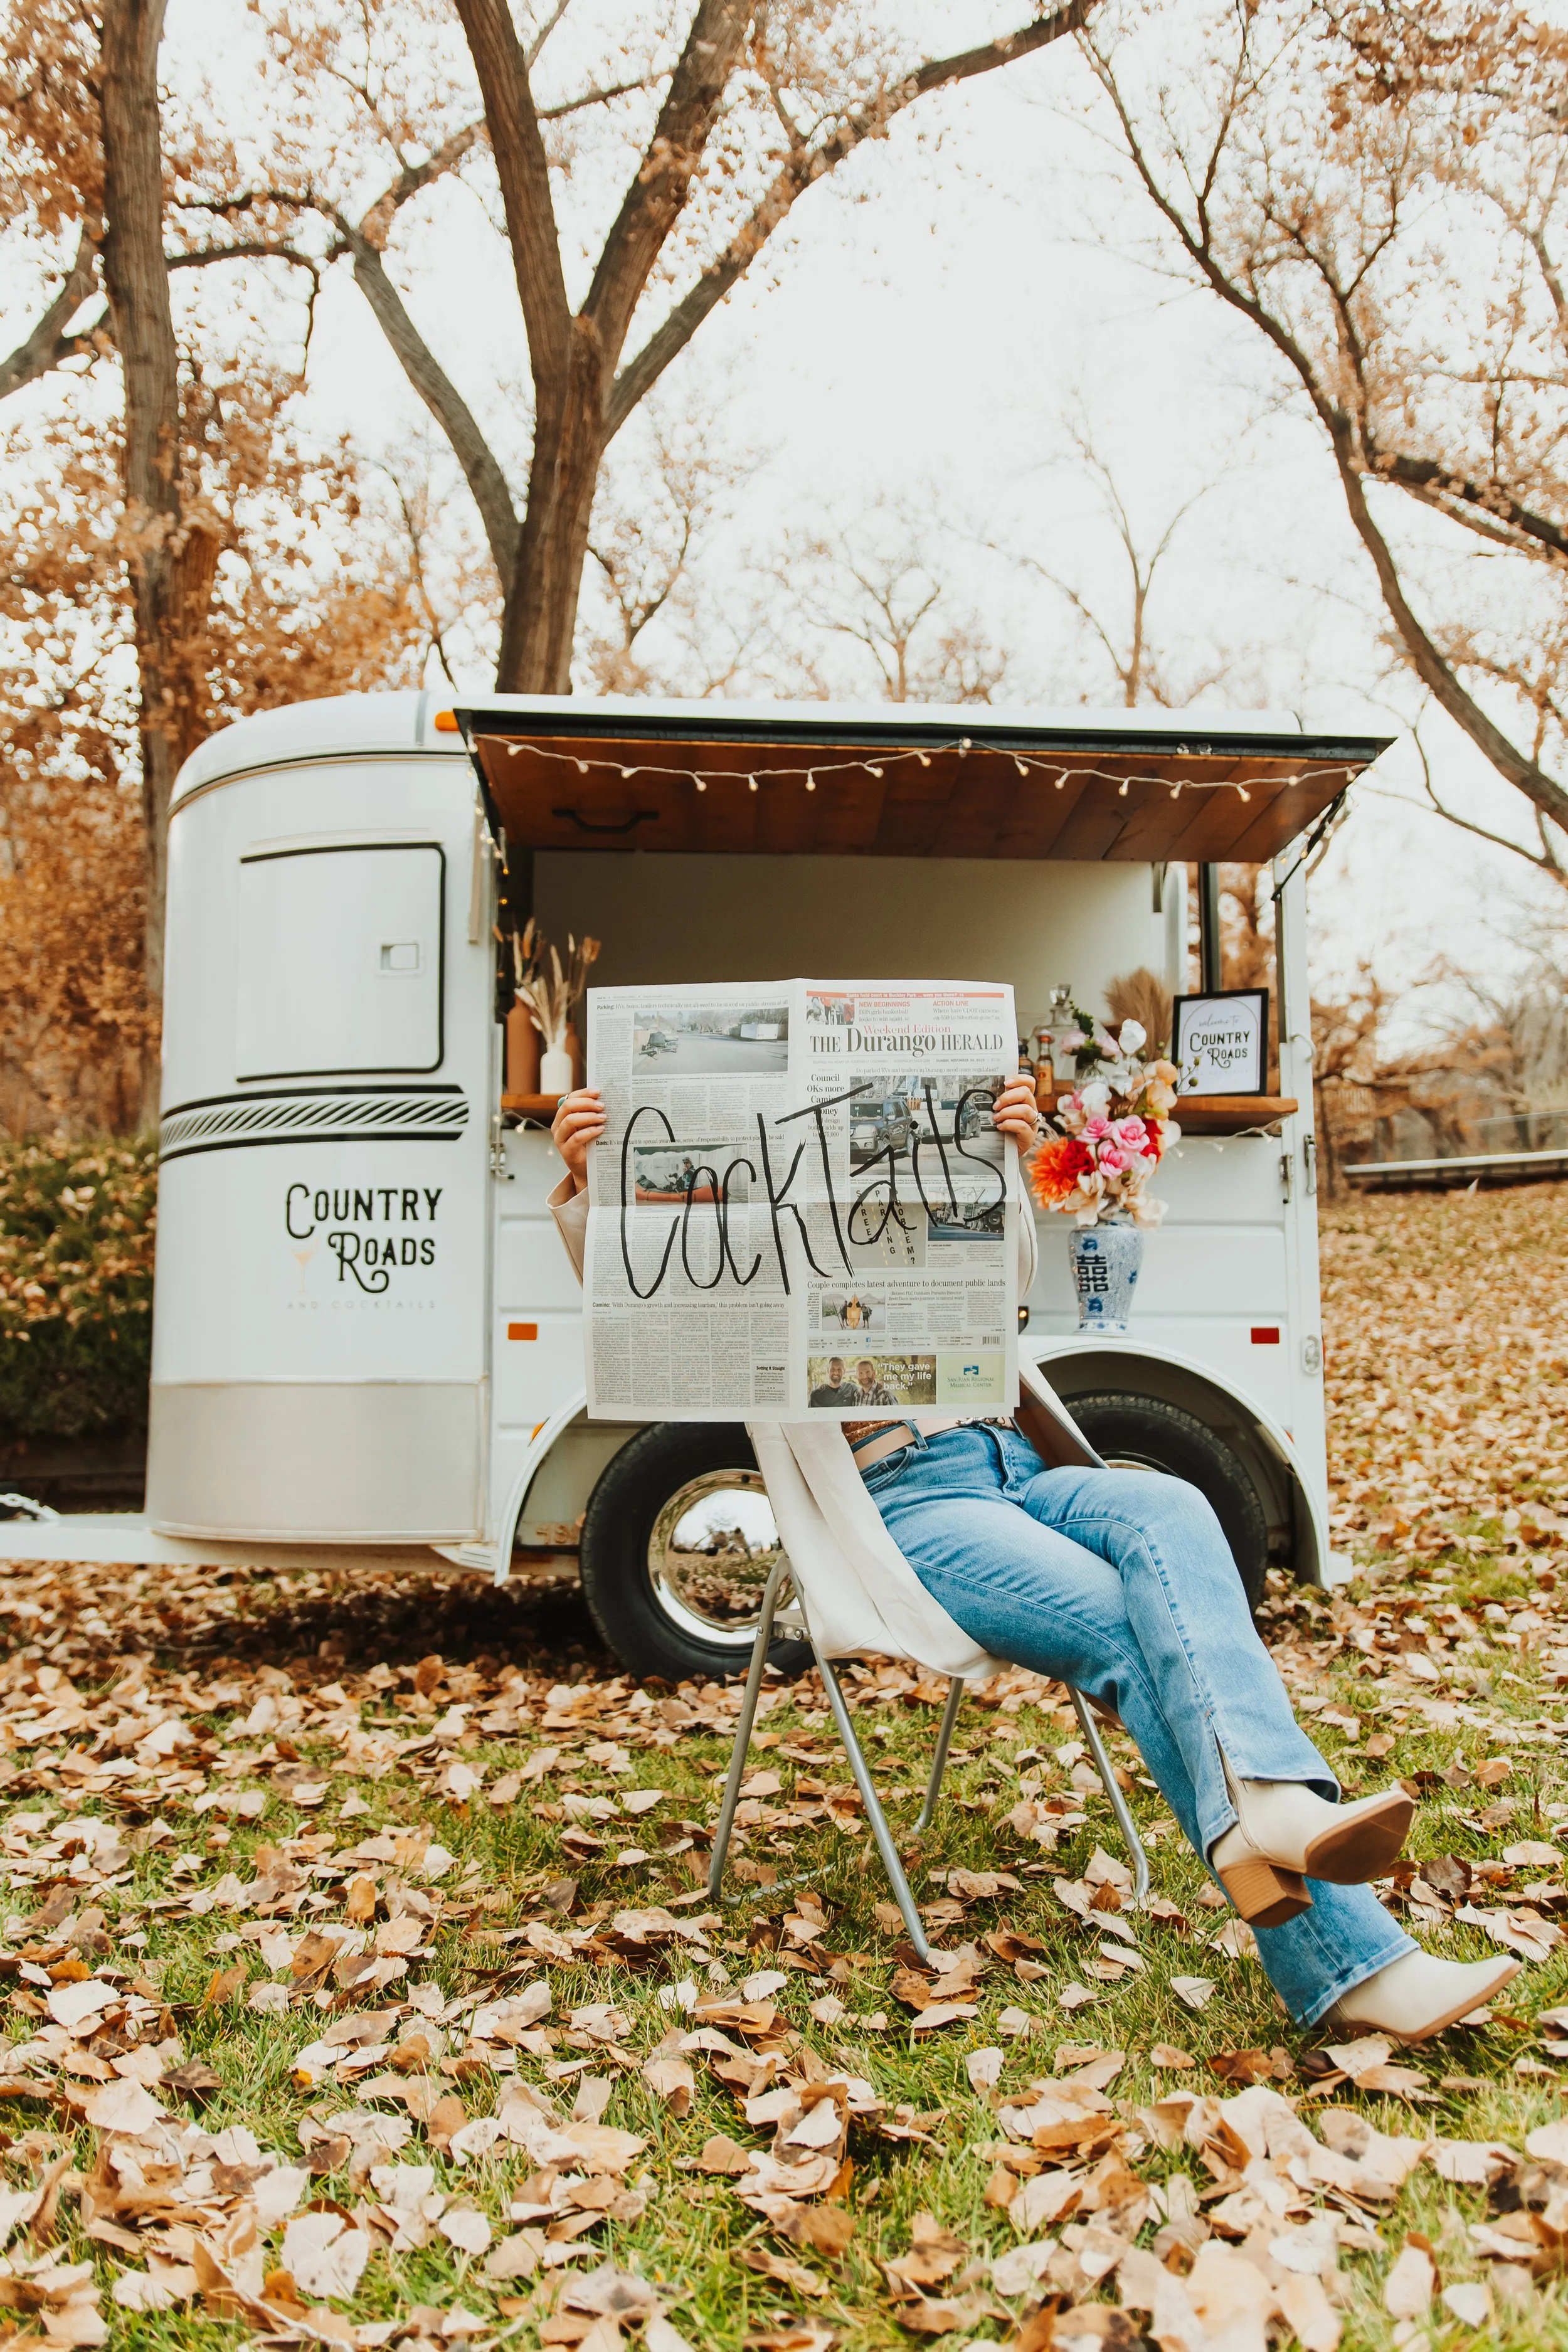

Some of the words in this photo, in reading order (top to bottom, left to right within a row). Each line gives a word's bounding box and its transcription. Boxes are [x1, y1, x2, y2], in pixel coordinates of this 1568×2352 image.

[863, 1025, 909, 1034] Weekend
[913, 1024, 951, 1034] Edition
[810, 1036, 841, 1052] THE
[846, 1027, 936, 1058] Durango
[941, 1034, 1004, 1051] HERALD
[1190, 1030, 1250, 1052] COUNTRY
[1207, 1047, 1248, 1068] ROADS
[813, 1108, 839, 1116] oney
[285, 1182, 443, 1239] COUNTRY
[327, 1231, 436, 1294] ROADS
[807, 1281, 830, 1290] Couple
[832, 1281, 866, 1290] completes
[965, 1279, 986, 1288] public
[286, 1300, 319, 1310] AND
[331, 1300, 437, 1310] COCKTAILS
[901, 1374, 914, 1382] my
[917, 1372, 932, 1380] life
